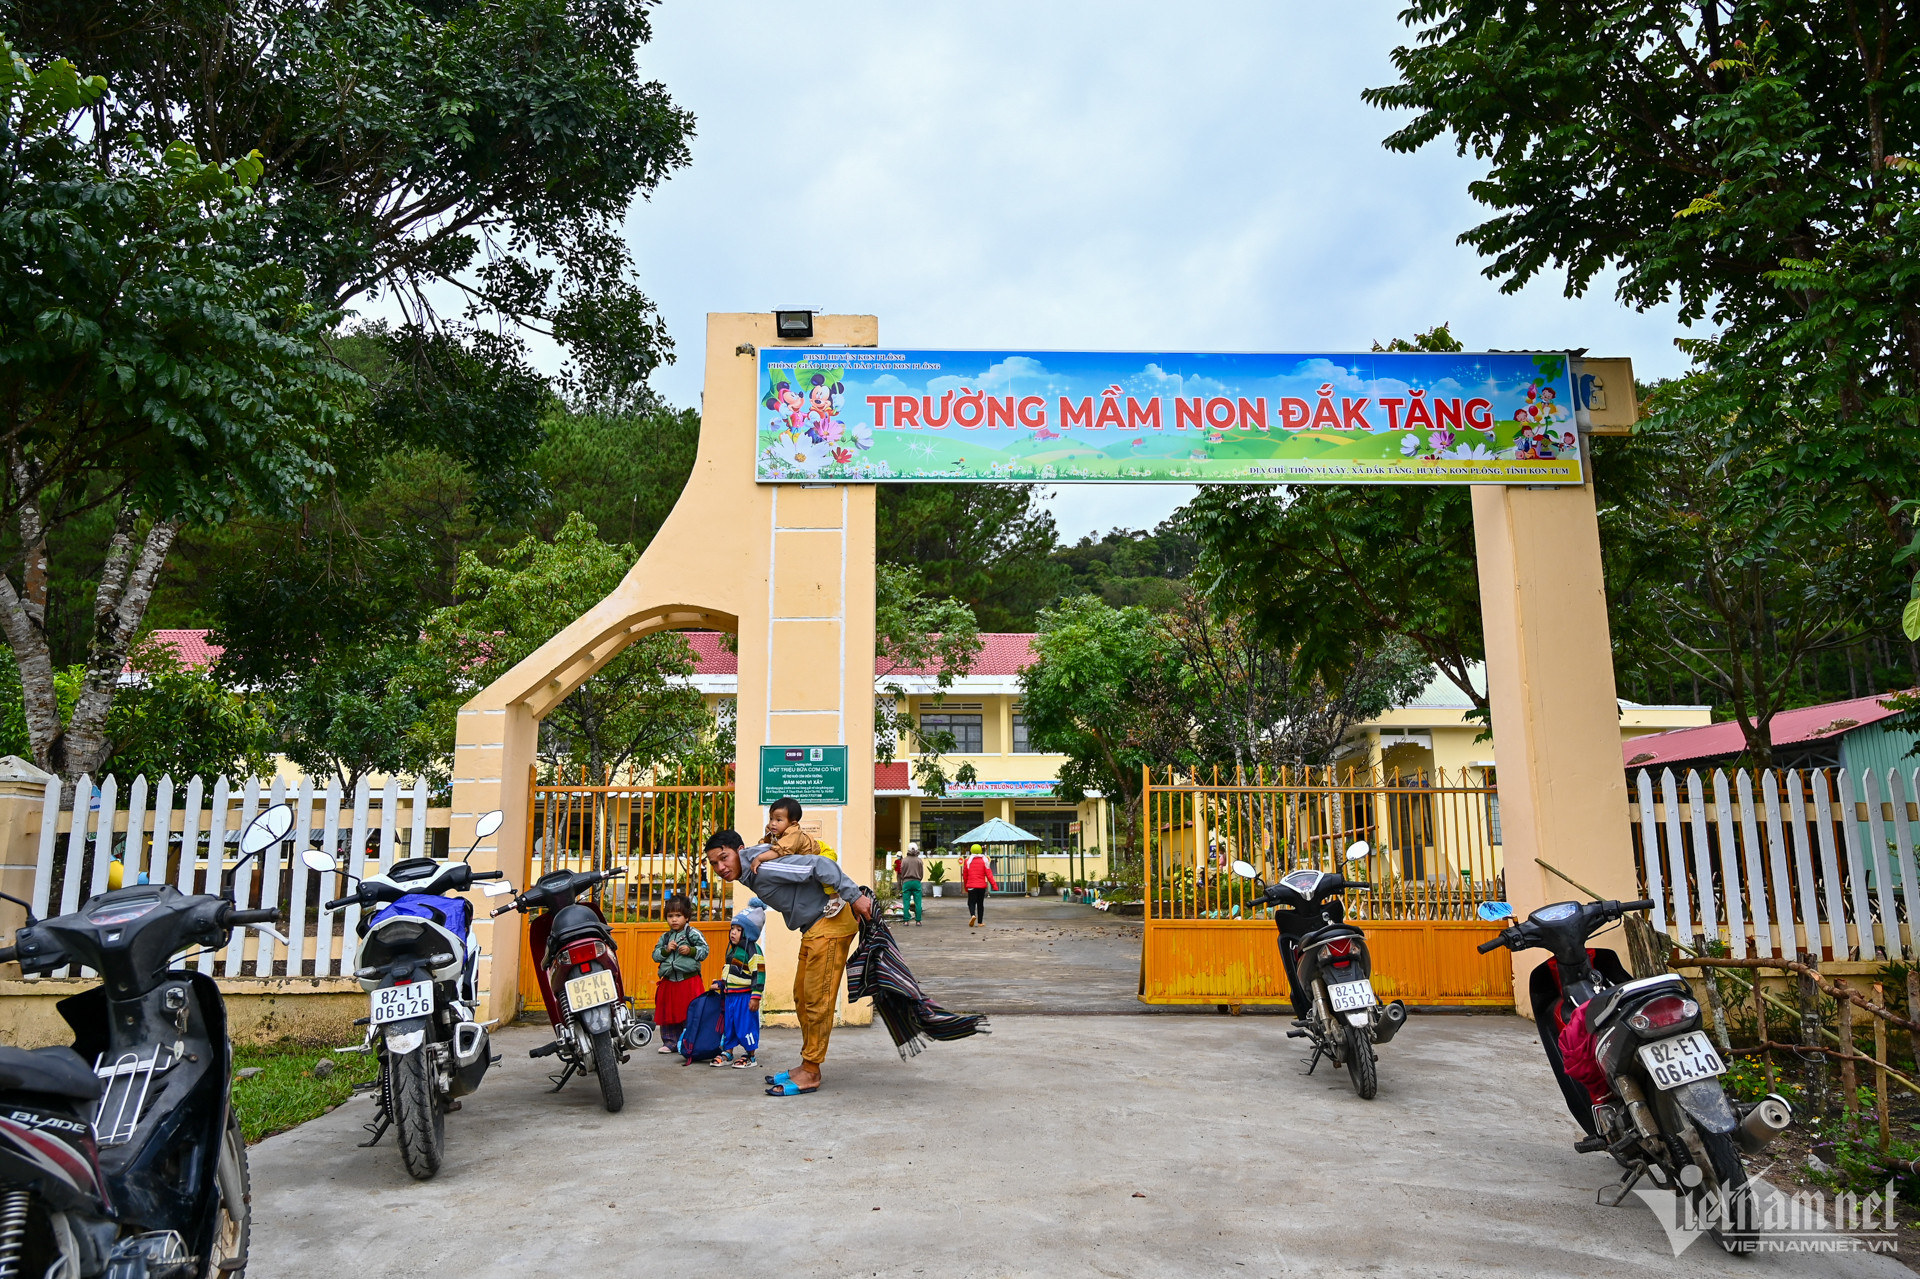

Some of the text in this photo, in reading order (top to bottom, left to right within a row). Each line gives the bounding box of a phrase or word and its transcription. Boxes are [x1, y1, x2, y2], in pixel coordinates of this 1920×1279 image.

[873, 363, 891, 371] TẠO
[866, 383, 1495, 432] TRƯỜNG MẦM NON ĐẮK TĂNG
[1289, 465, 1314, 474] THÔN
[1416, 466, 1447, 476] HUYỆN
[1450, 467, 1468, 475] KON
[1529, 467, 1548, 475] KON
[1550, 467, 1570, 475] TUM
[381, 985, 422, 1005] 82-L1
[576, 988, 610, 1008] 9316
[1335, 983, 1365, 997] 82-L1
[375, 999, 430, 1021] 069.26
[1334, 994, 1373, 1009] 059.12
[745, 1032, 755, 1046] 11
[1650, 1036, 1701, 1063] 82-E1
[1655, 1053, 1720, 1085] 064.40
[10, 1111, 88, 1134] BLADE
